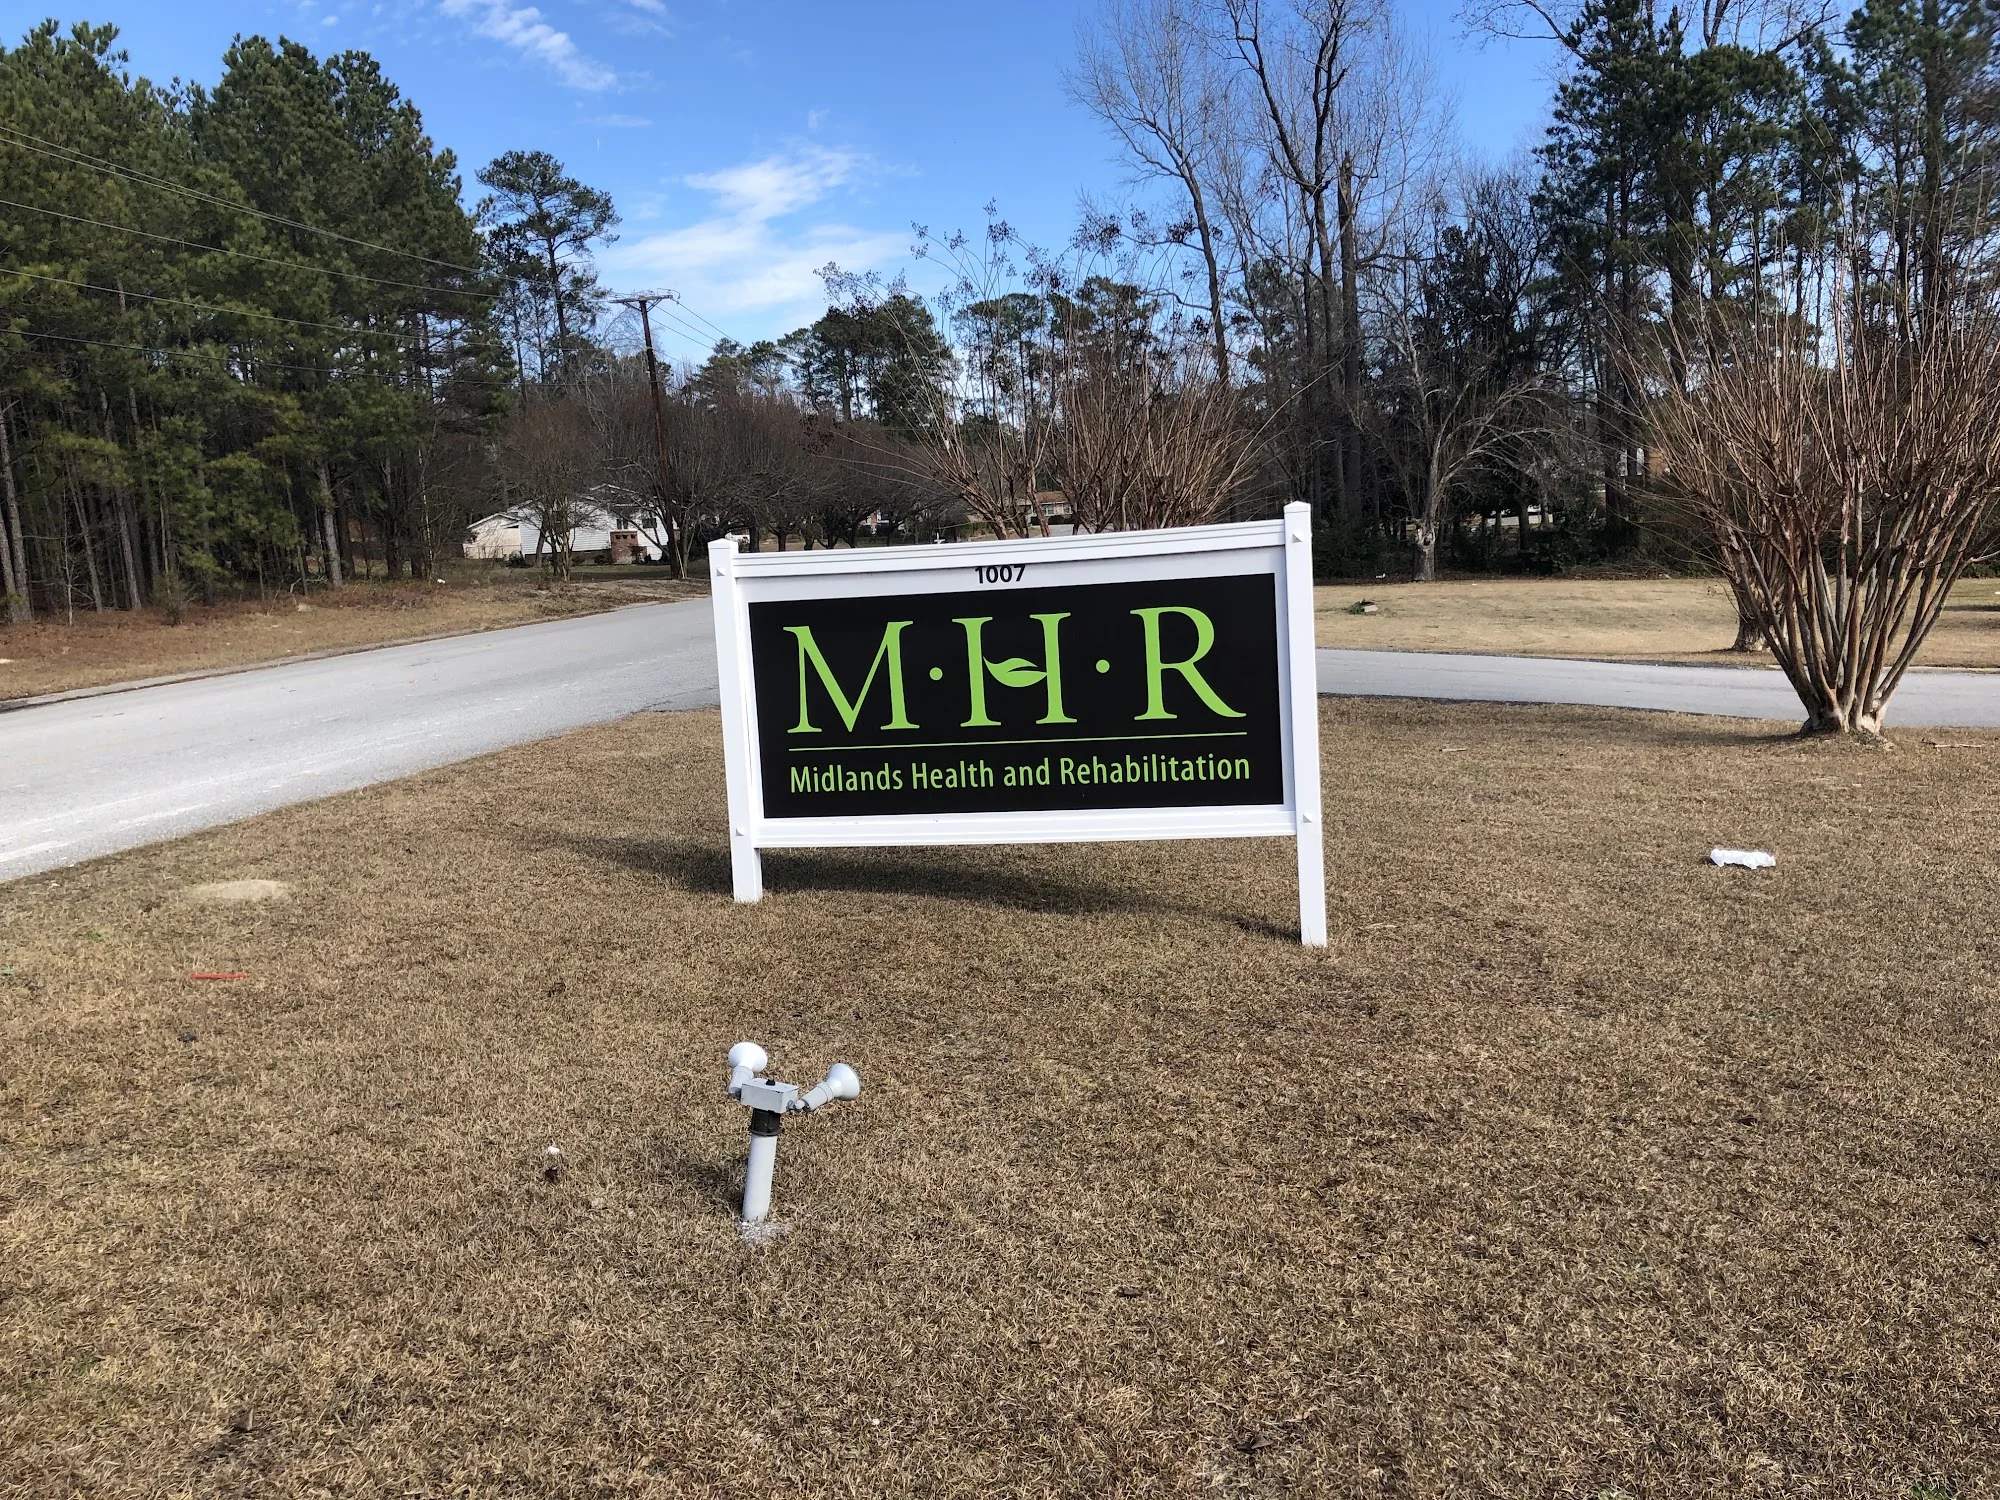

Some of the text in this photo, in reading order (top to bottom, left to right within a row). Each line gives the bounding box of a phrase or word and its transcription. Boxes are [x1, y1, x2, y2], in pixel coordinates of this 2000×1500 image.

[974, 563, 1026, 584] 1007
[791, 754, 1250, 792] Midlands Health and Rehabilitation
